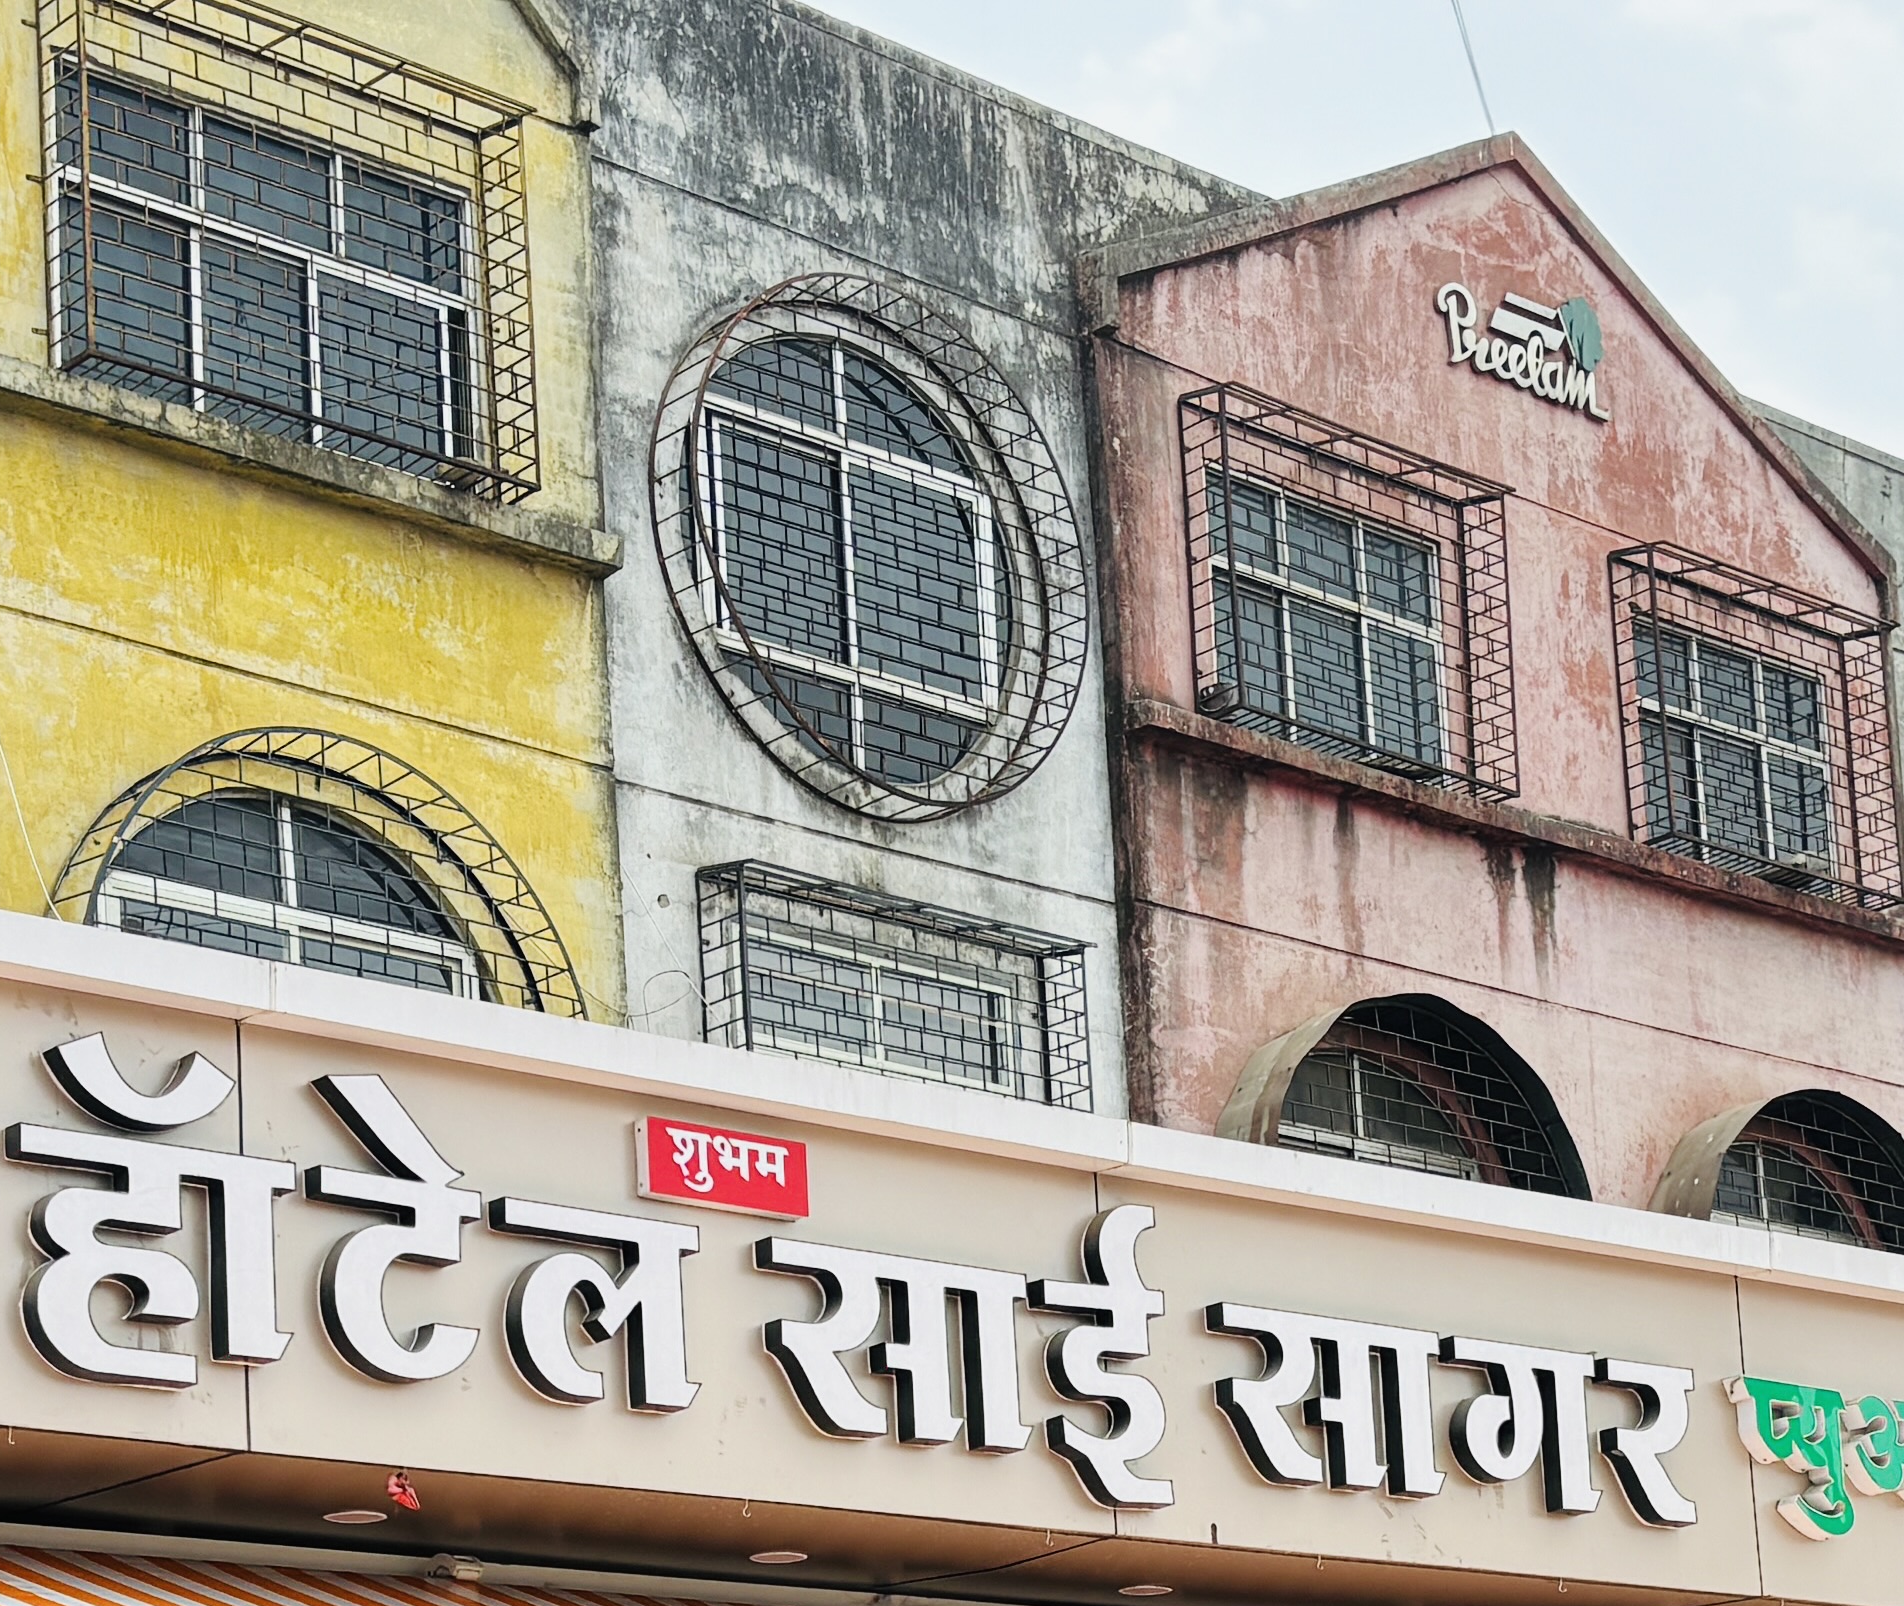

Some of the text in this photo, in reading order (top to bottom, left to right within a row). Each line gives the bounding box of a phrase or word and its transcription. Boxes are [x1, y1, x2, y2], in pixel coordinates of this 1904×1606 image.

[5, 1032, 700, 1415] हॉटेल
[754, 1203, 1174, 1510] साई
[1204, 1301, 1696, 1527] सागर
[665, 1126, 789, 1193] शुभम
